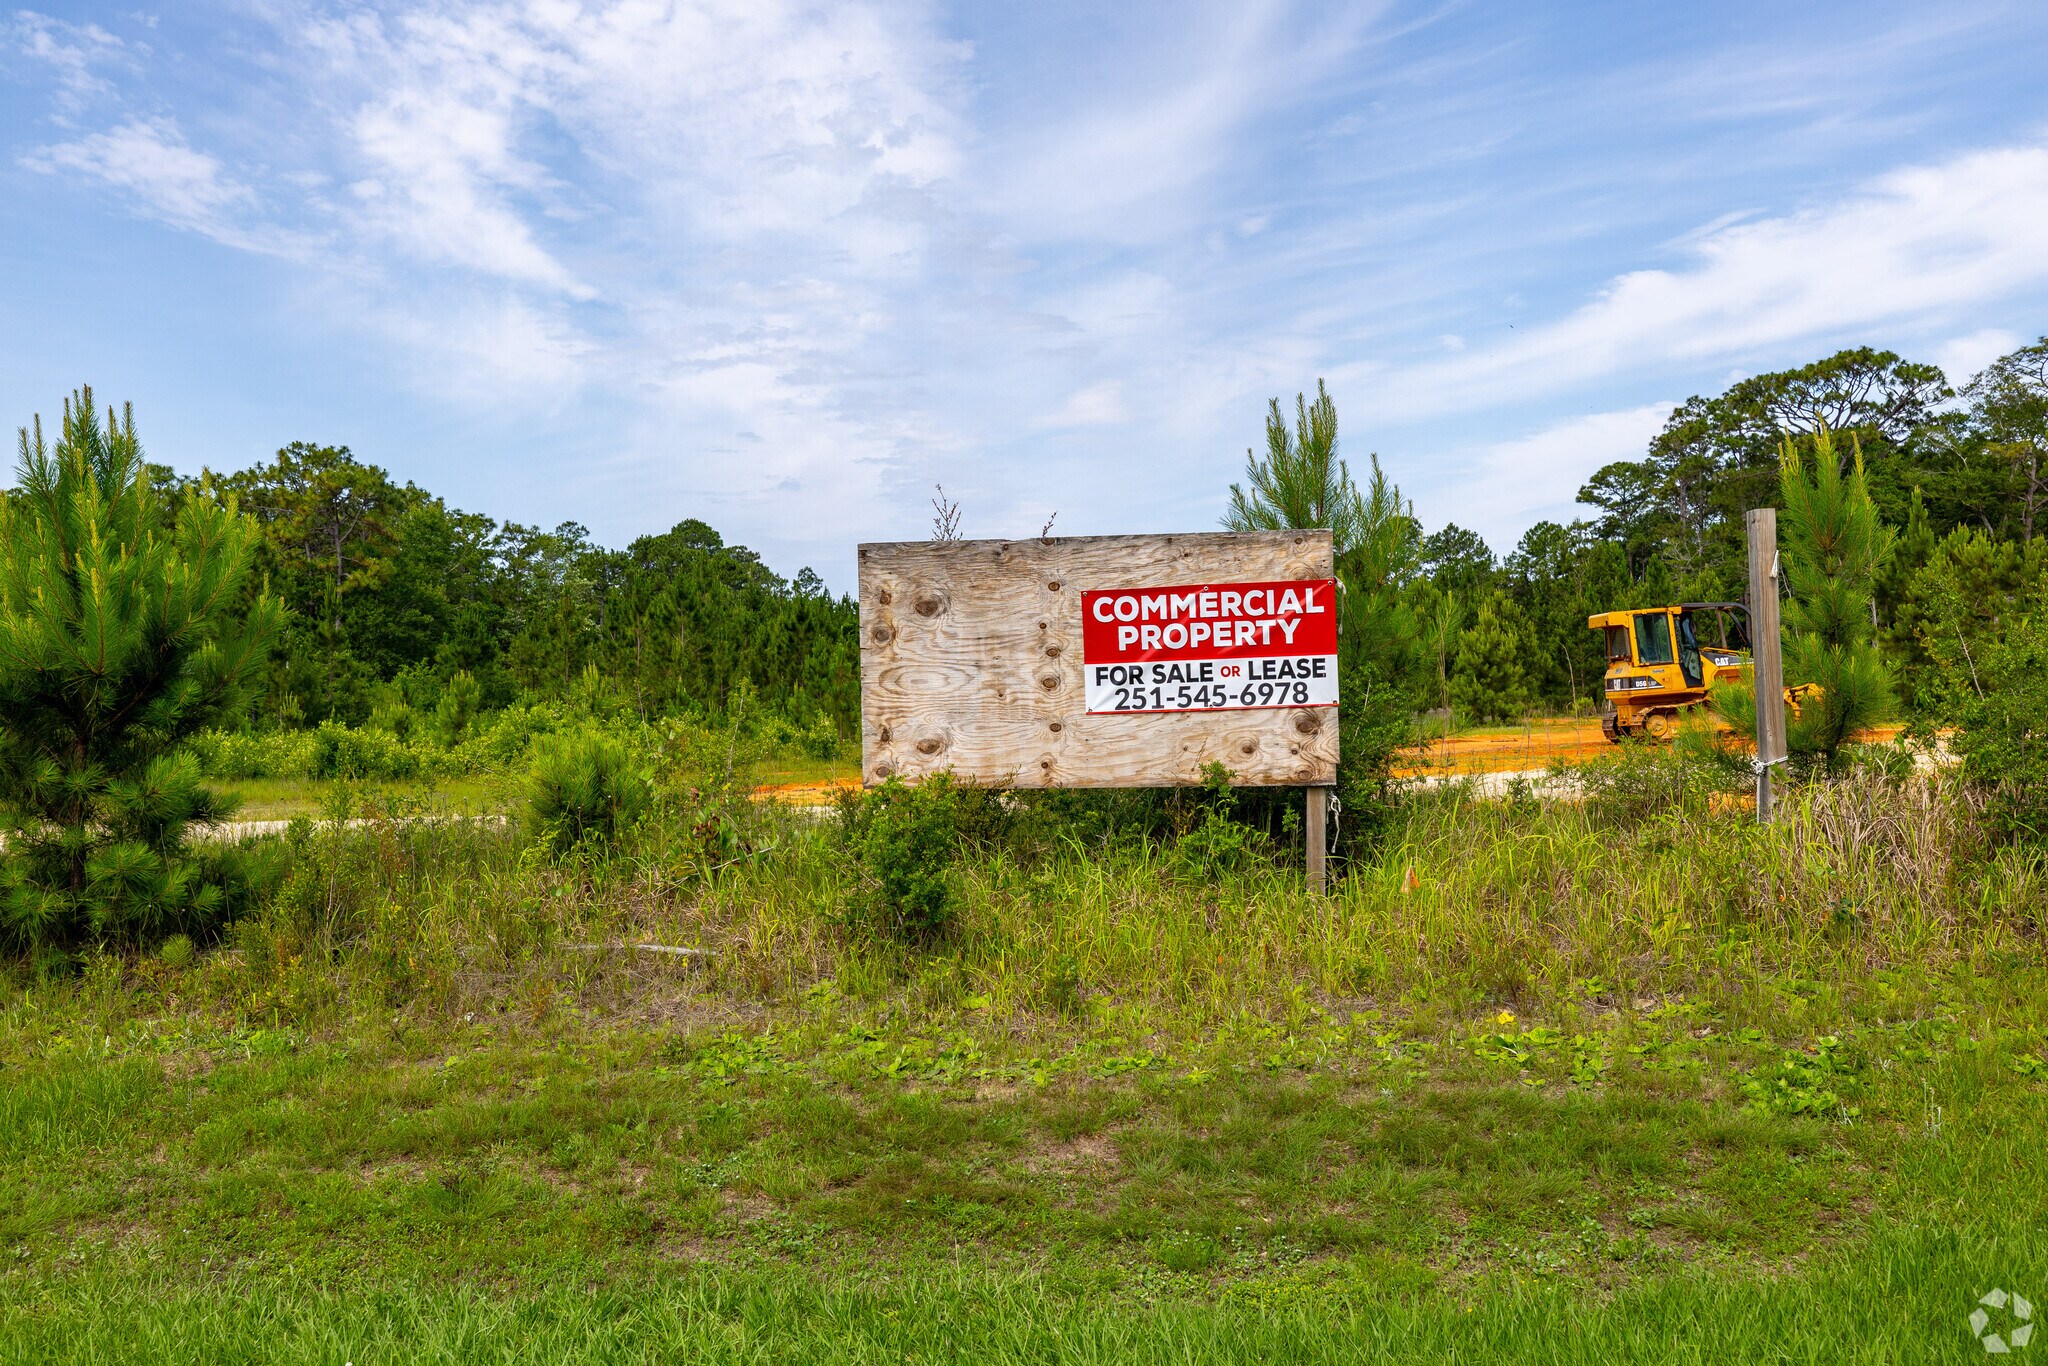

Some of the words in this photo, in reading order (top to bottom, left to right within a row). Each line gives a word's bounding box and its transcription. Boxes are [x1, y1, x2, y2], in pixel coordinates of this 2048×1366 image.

[1093, 588, 1325, 623] COMMERCIAL
[1118, 618, 1301, 651] PROPERTY
[1095, 666, 1144, 686] FOR
[1152, 662, 1214, 684] SALE
[1220, 665, 1241, 677] OR
[1248, 658, 1326, 680] LEASE
[1714, 657, 1729, 666] CAT
[1114, 681, 1309, 711] 251-545-6978
